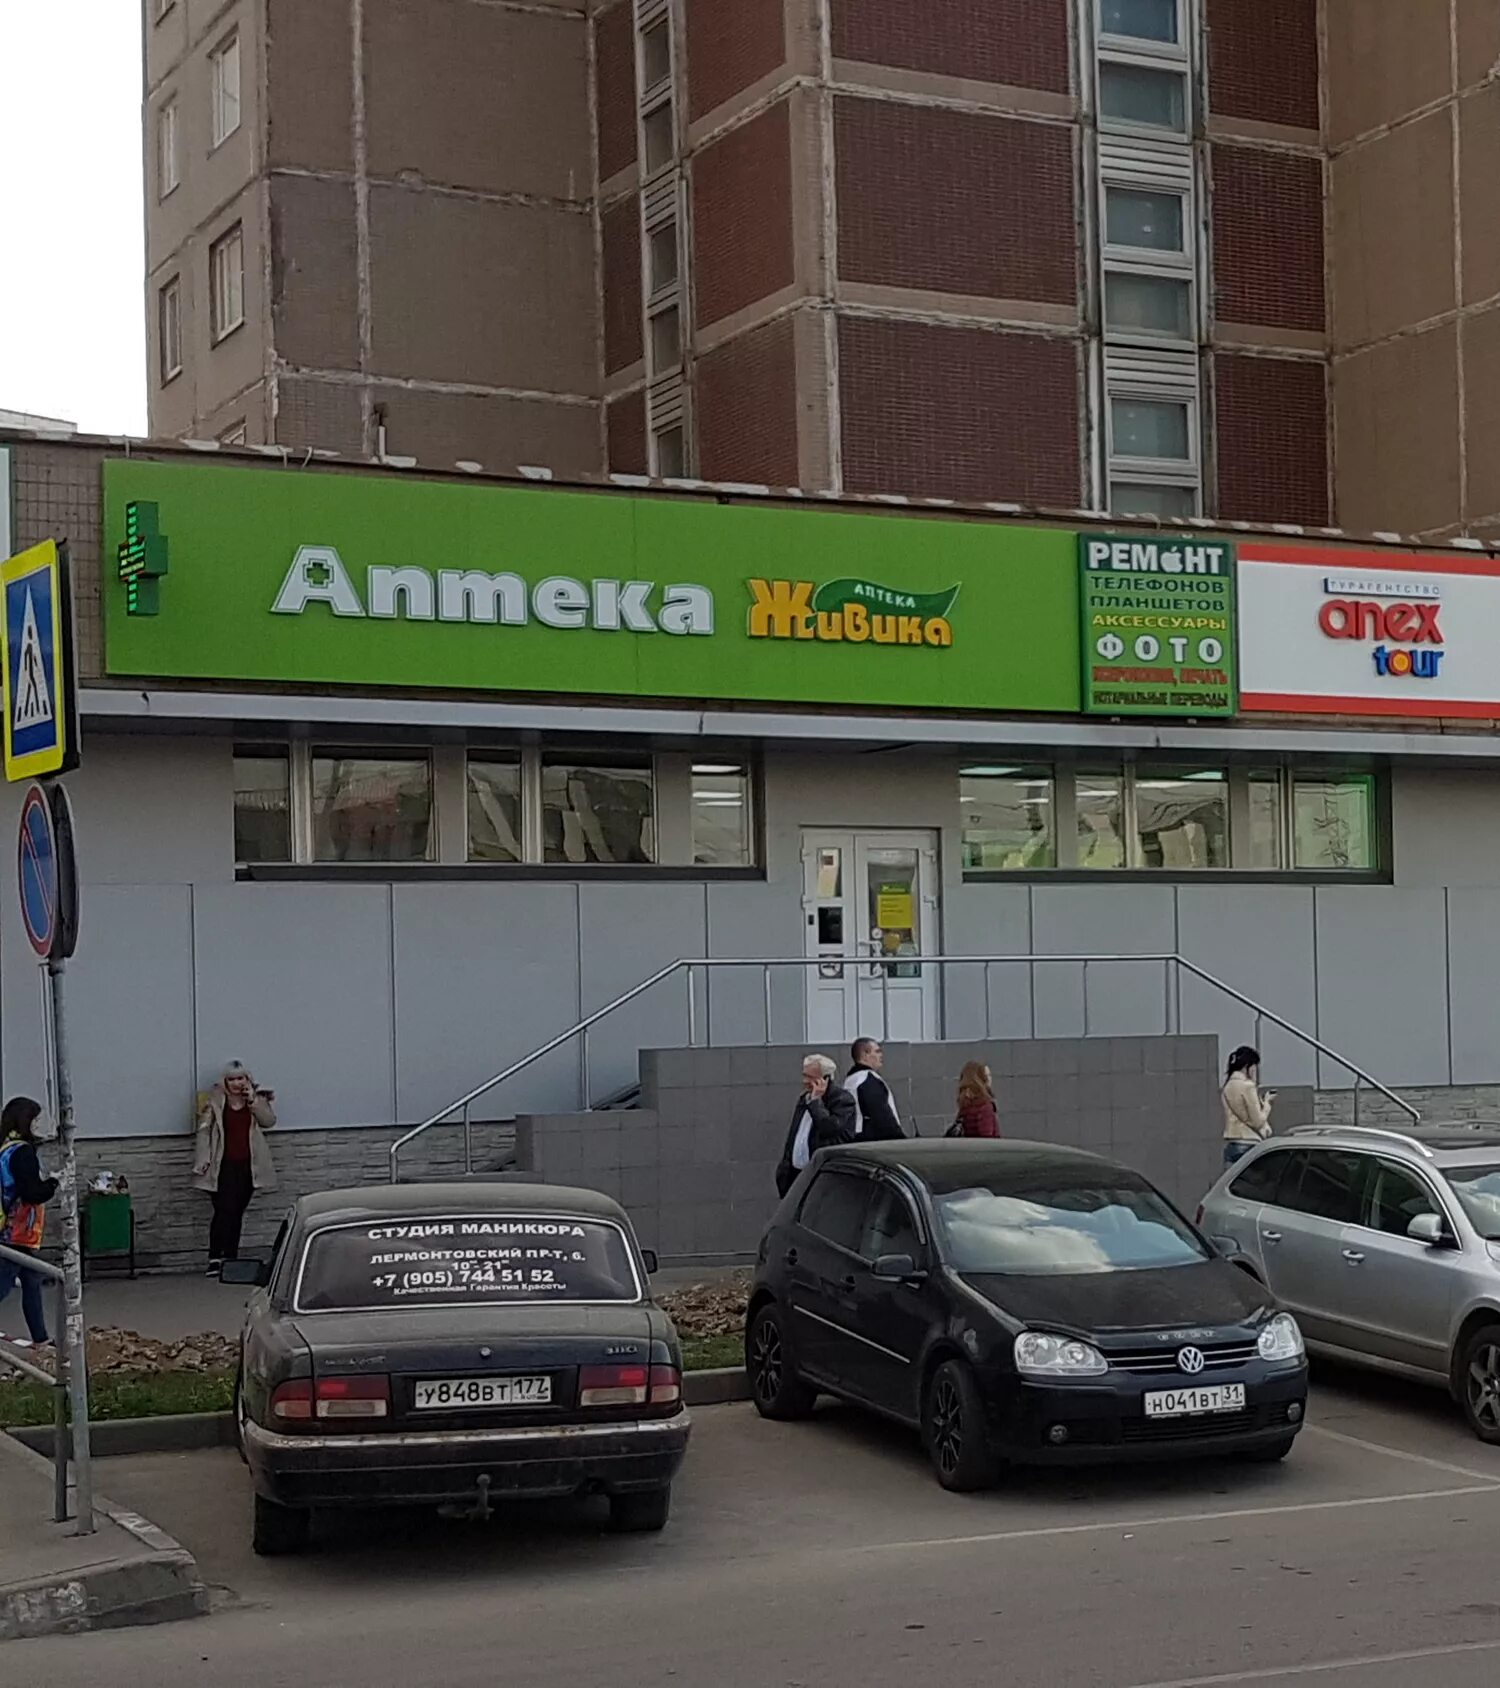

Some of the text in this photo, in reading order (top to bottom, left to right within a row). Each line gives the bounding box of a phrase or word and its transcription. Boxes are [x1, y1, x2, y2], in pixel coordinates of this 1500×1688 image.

[268, 544, 714, 635] Аптека
[1090, 575, 1224, 594] ТЕЛЕФОНОВ
[1330, 580, 1440, 594] ТУРАГЕНТСТВО
[854, 583, 915, 608] АПТЕКА
[1090, 595, 1224, 611] ПЛАНШЕТОВ
[747, 578, 953, 646] Живика
[1092, 614, 1226, 630] АКСЕССУАРЫ
[1318, 599, 1444, 644] anex
[1096, 632, 1223, 664] ФОТО
[1372, 645, 1444, 678] tour
[368, 1222, 586, 1240] СТУДИЯ МАНИКЮРА
[369, 1247, 522, 1265] ЛЕРМОНТОВСКИЙ
[372, 1269, 554, 1288] +7 (905) 744 51 52
[424, 1381, 509, 1404] У848ВТ
[1152, 1391, 1219, 1412] Н041ВТ
